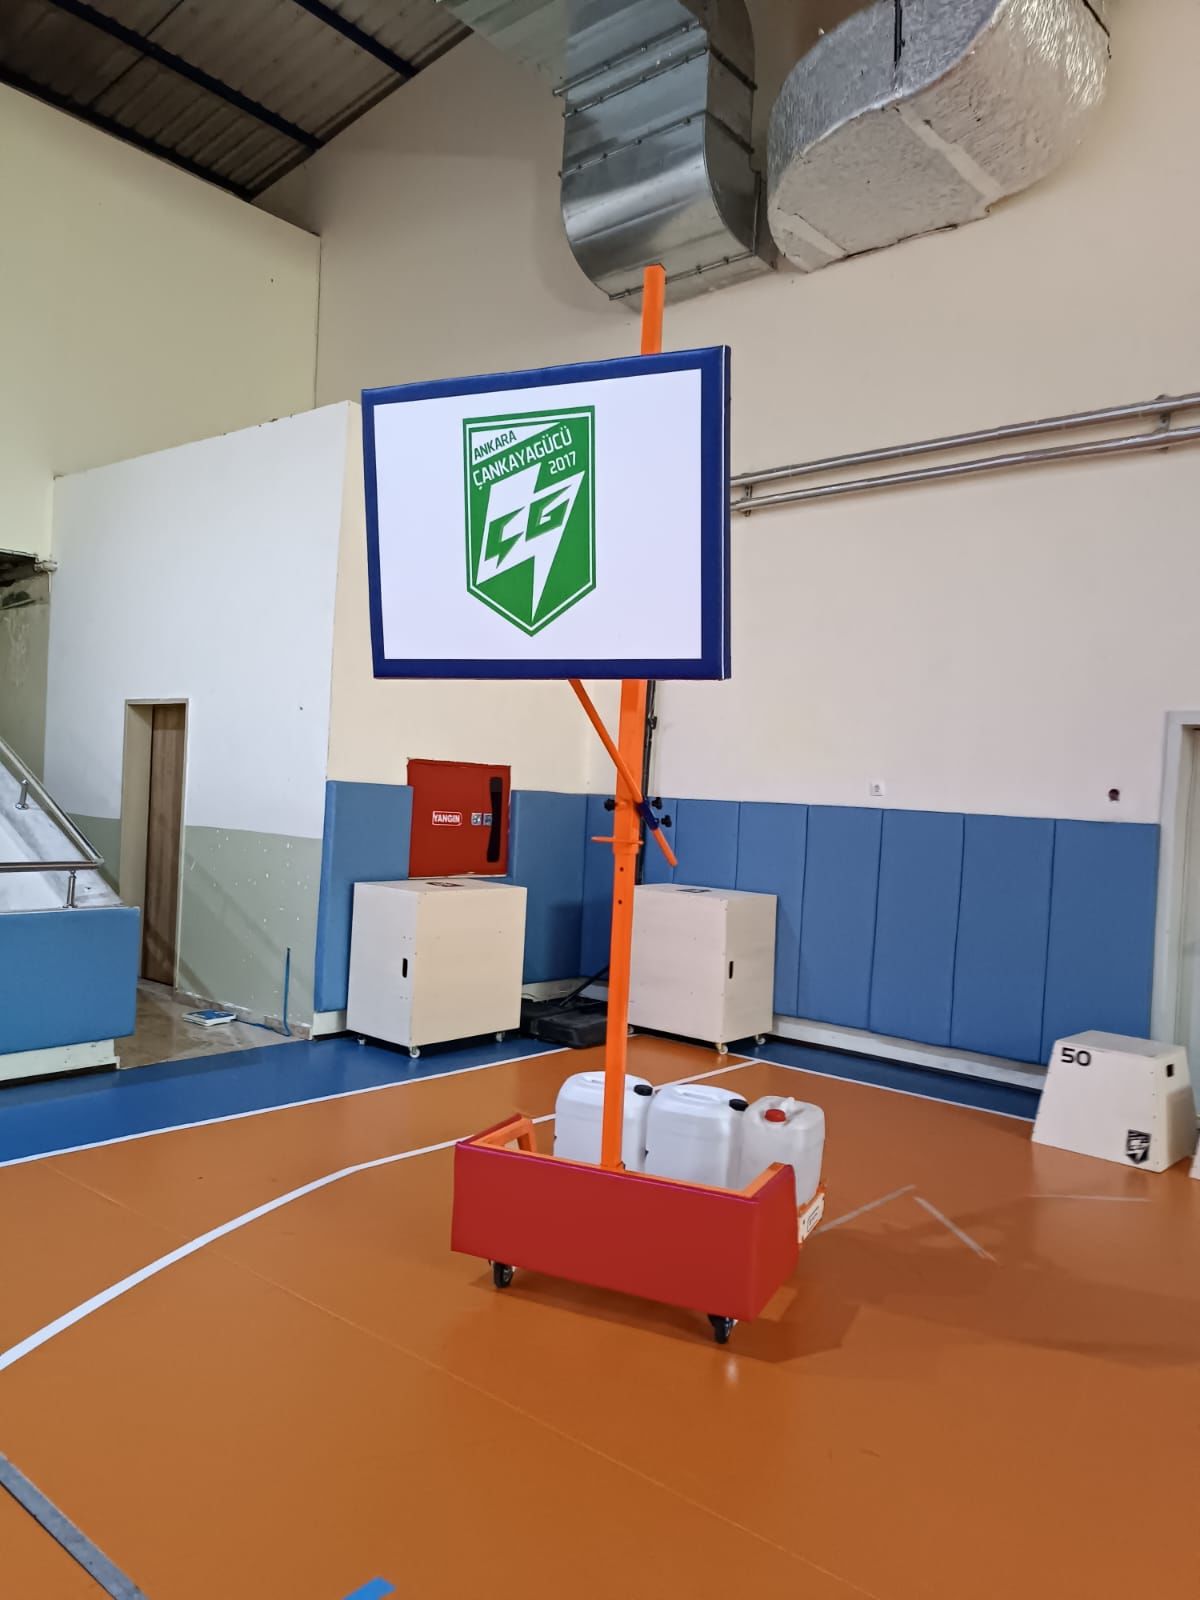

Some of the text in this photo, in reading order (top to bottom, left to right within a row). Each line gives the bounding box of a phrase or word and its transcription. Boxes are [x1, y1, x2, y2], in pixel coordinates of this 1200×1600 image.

[472, 425, 573, 490] ÇANKAYAGÜCÜ
[473, 430, 518, 461] ANKARA
[548, 450, 577, 475] 2017
[434, 813, 460, 823] YANGIN
[1061, 1047, 1092, 1066] 50
